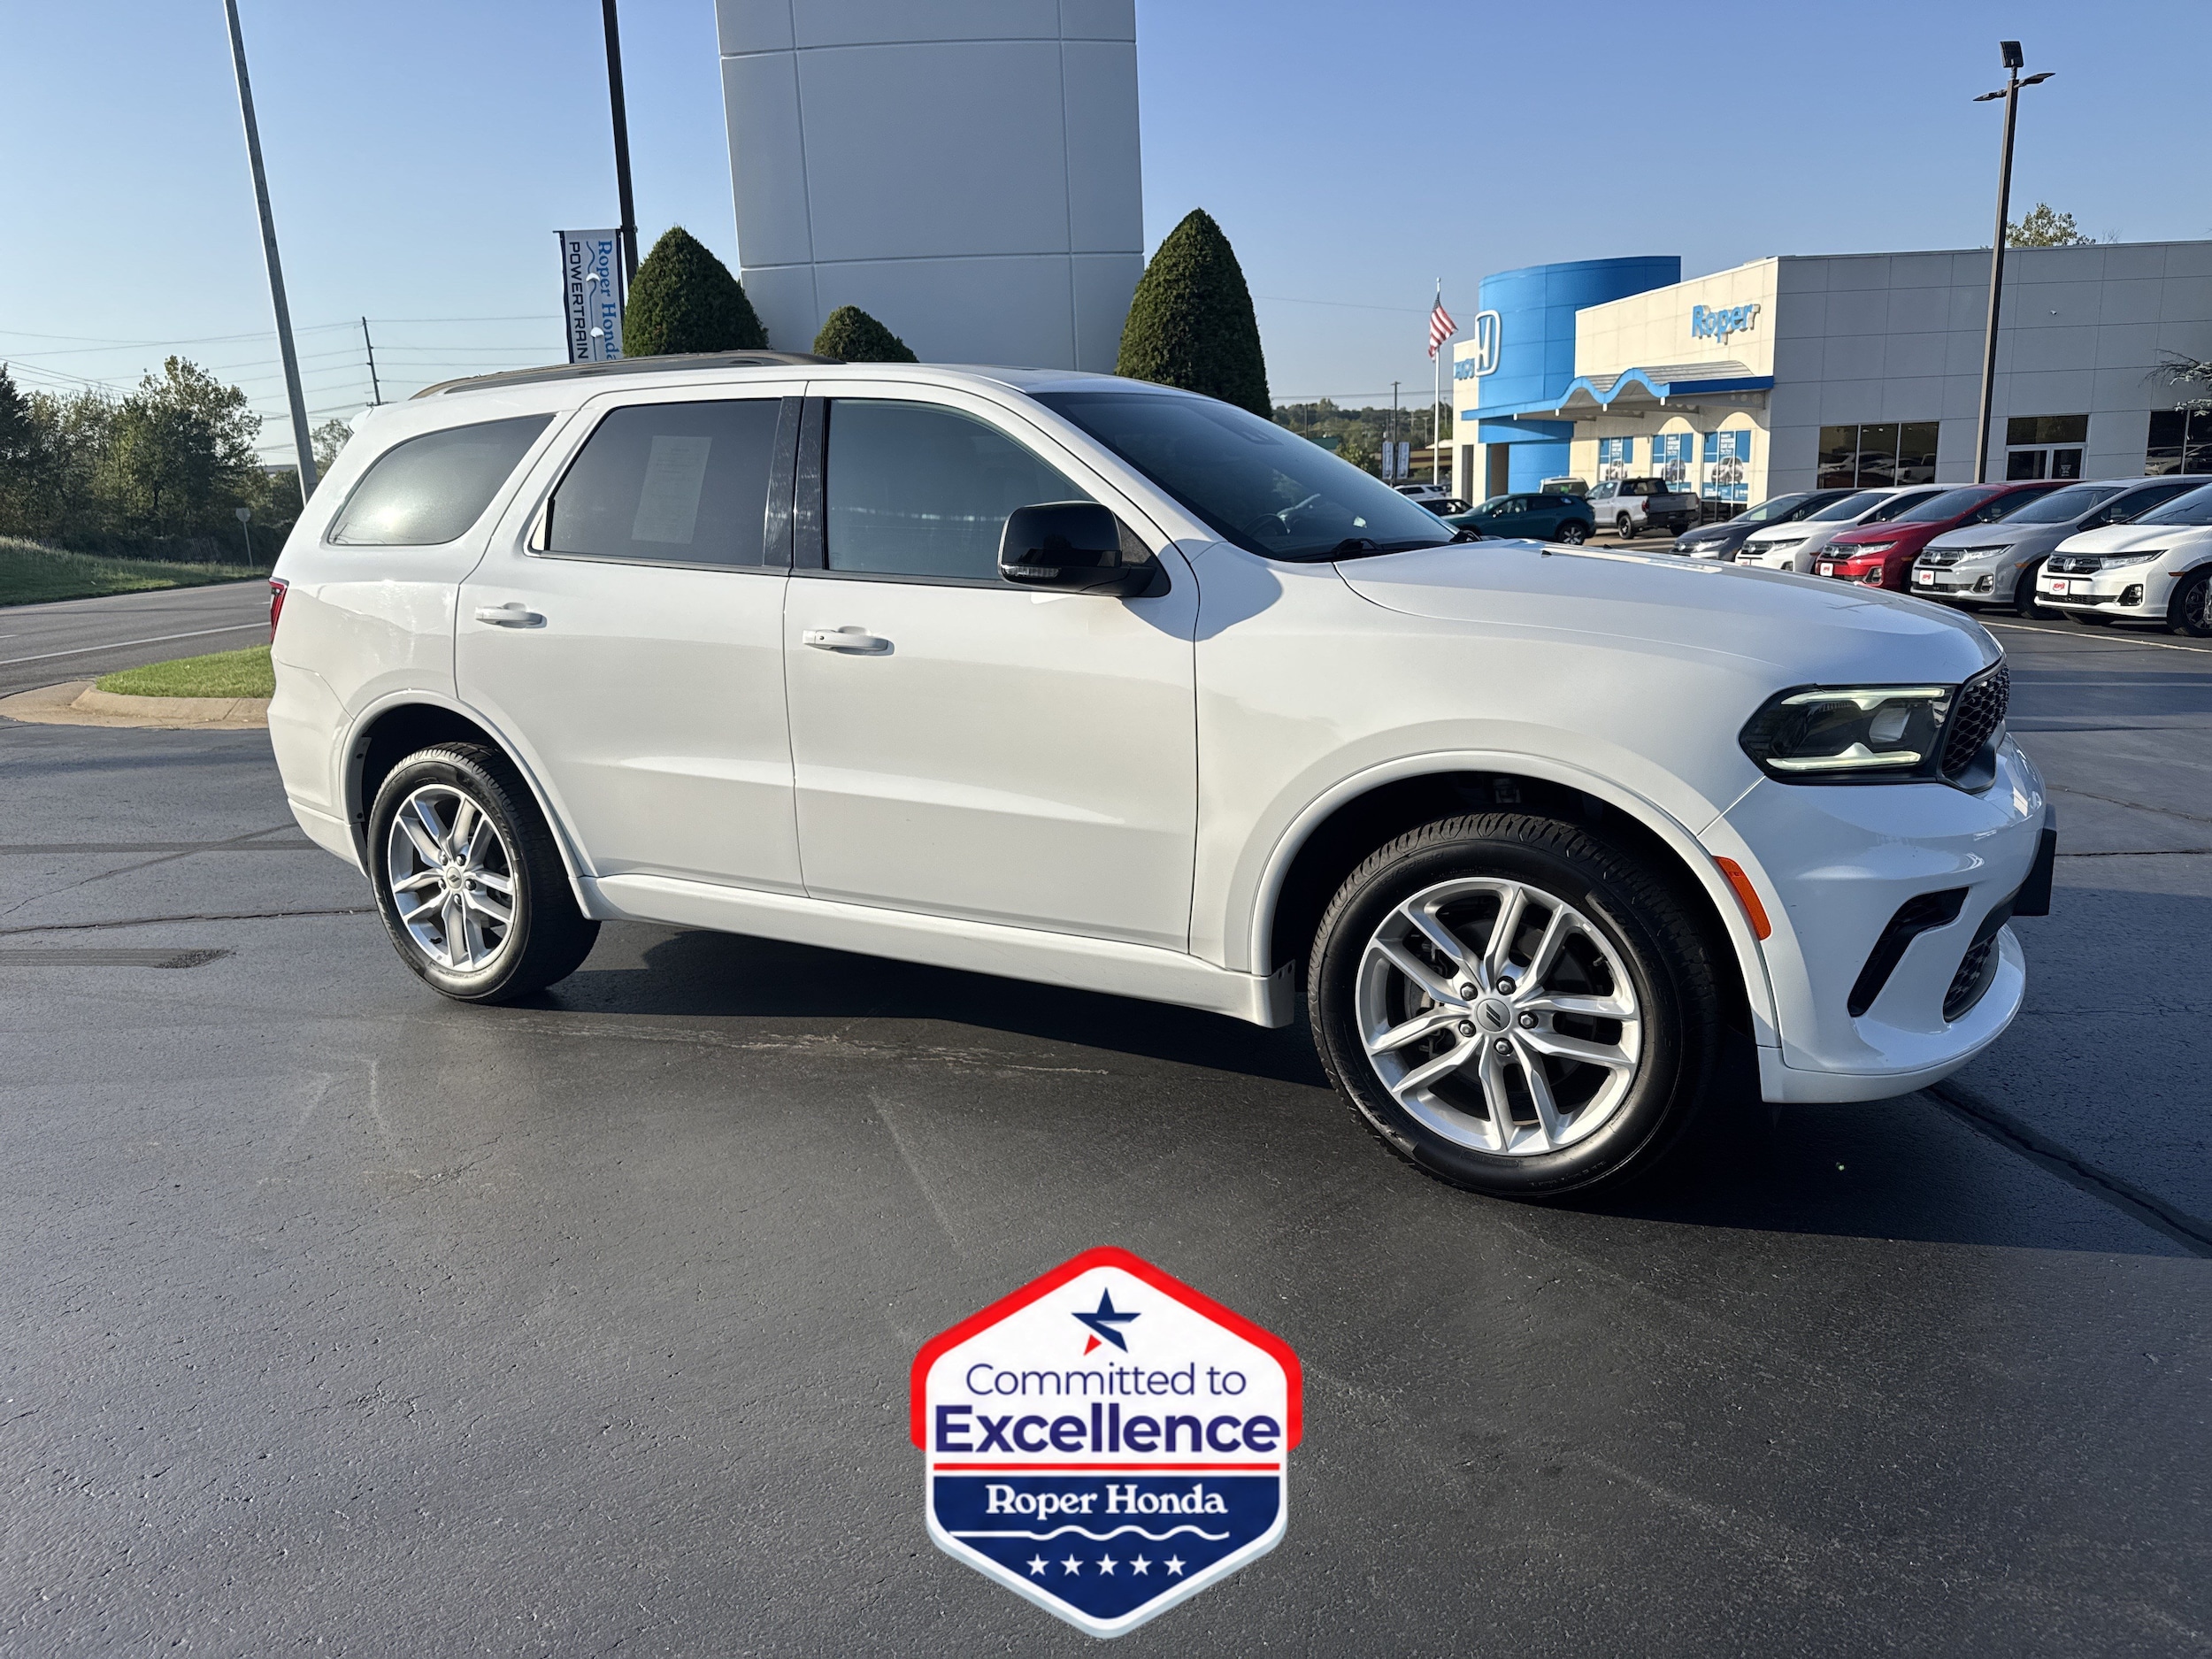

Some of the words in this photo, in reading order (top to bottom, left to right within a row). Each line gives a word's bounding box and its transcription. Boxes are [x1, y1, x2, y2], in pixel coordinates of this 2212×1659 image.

[596, 240, 612, 297] Roper
[569, 242, 588, 358] POWERTRAIN
[1692, 303, 1757, 344] Roper
